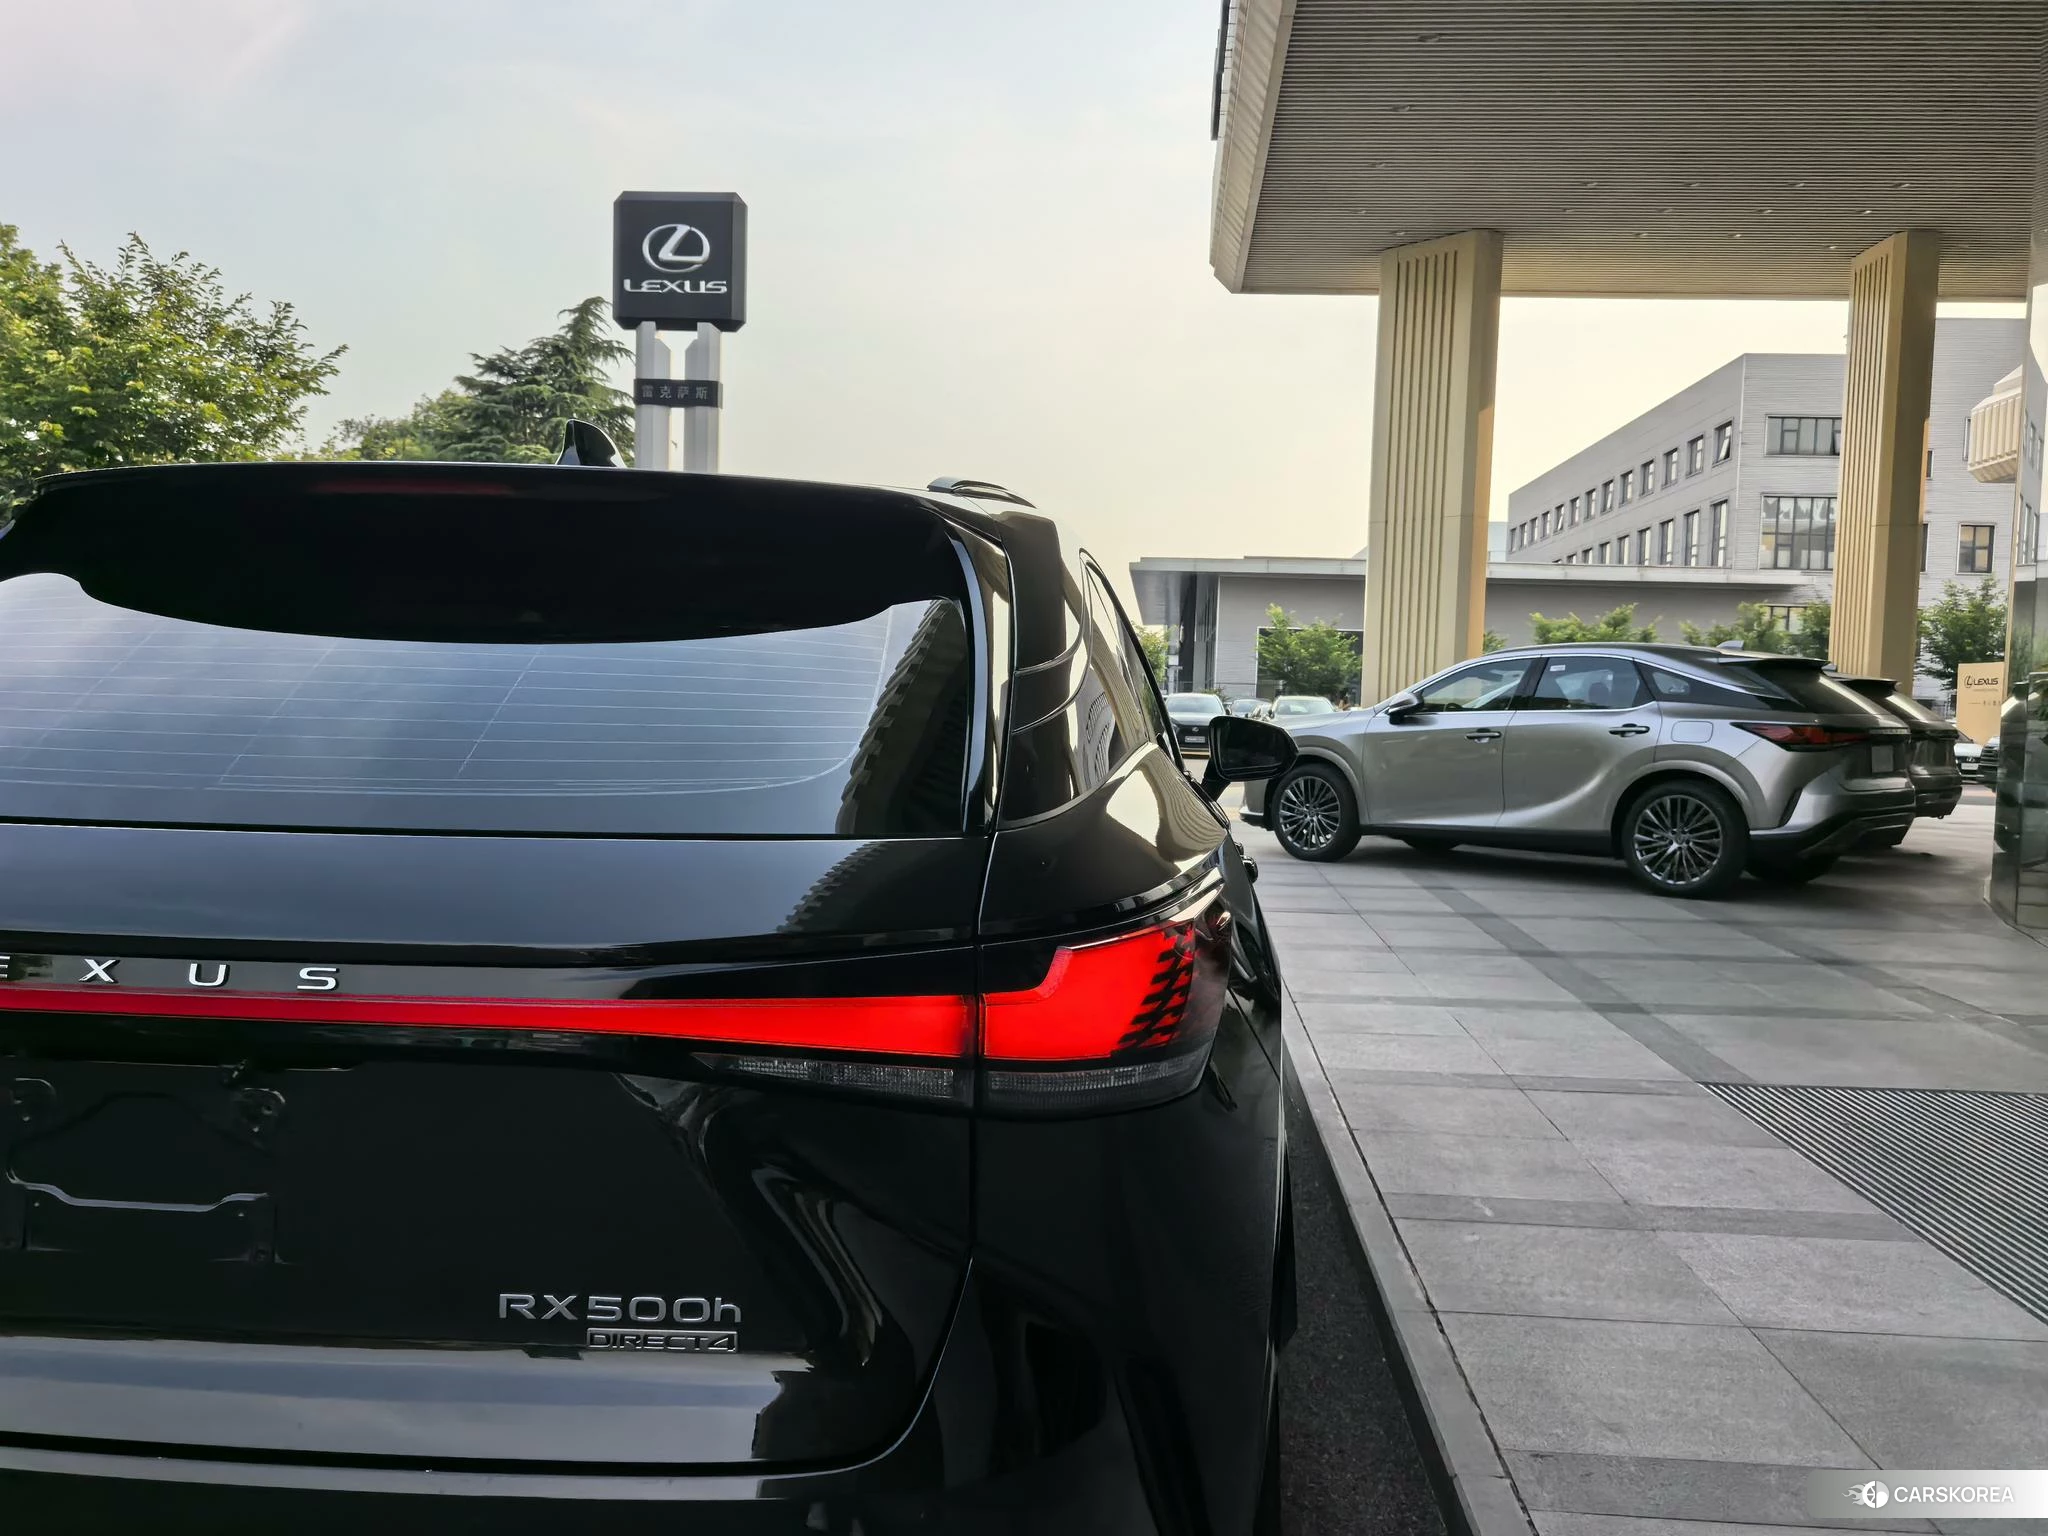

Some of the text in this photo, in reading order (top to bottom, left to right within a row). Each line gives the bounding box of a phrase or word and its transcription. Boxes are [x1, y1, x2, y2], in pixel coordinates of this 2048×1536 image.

[623, 278, 728, 294] LEXUS
[641, 384, 709, 400] 雷克萨斯
[1973, 677, 1999, 686] LEXUS
[0, 955, 338, 991] XUS
[589, 1333, 736, 1352] DIRECT4
